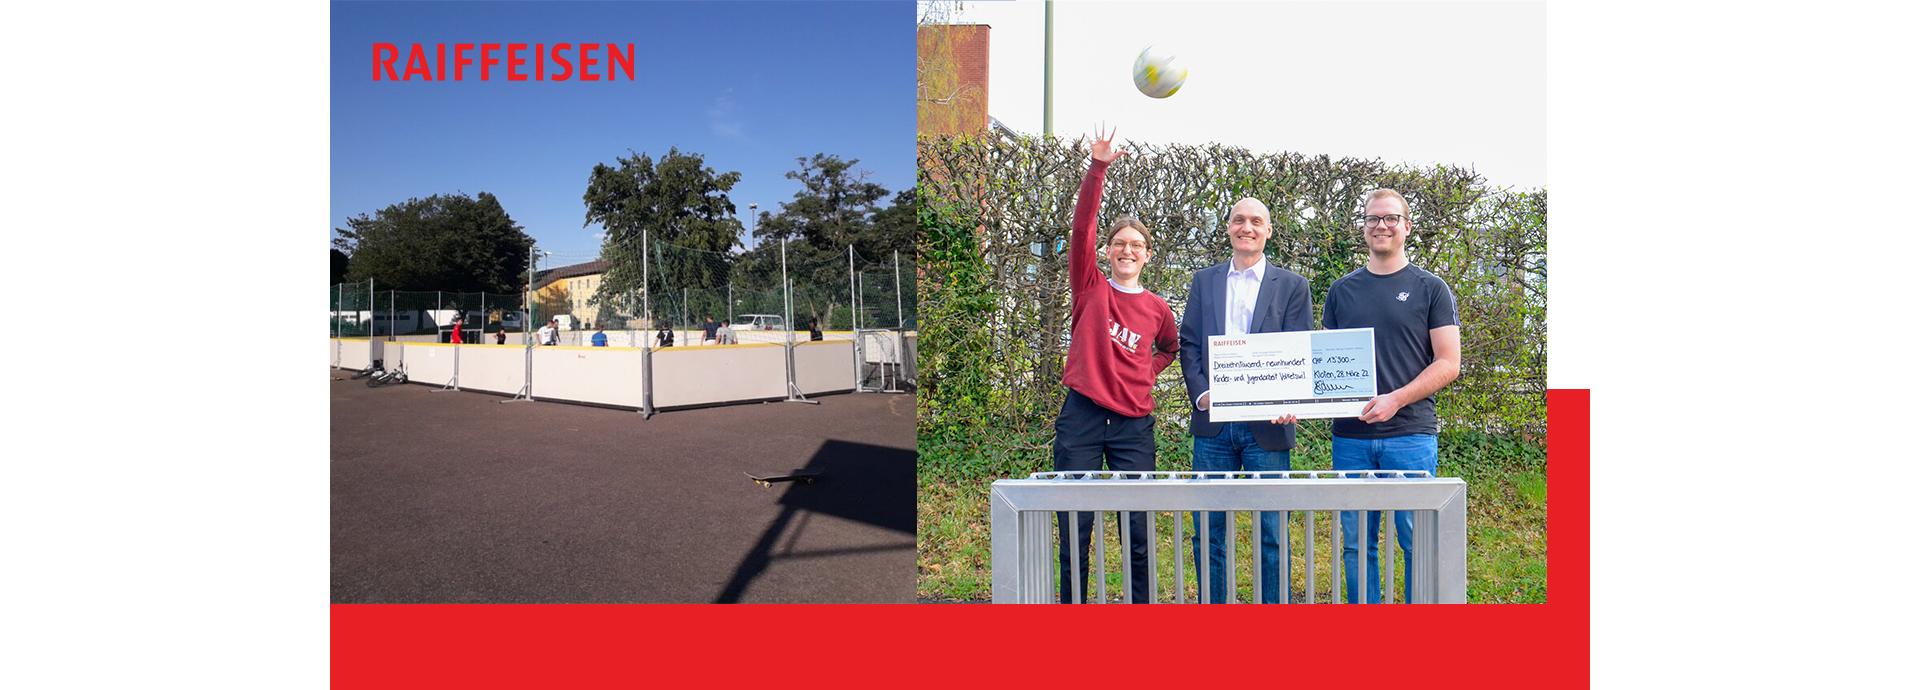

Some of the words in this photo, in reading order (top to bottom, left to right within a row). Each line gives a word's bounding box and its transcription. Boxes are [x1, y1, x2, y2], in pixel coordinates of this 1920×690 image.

[1213, 339, 1247, 347] RAIFFEISEN
[1361, 368, 1369, 377] 22
[1233, 374, 1245, 382] und
